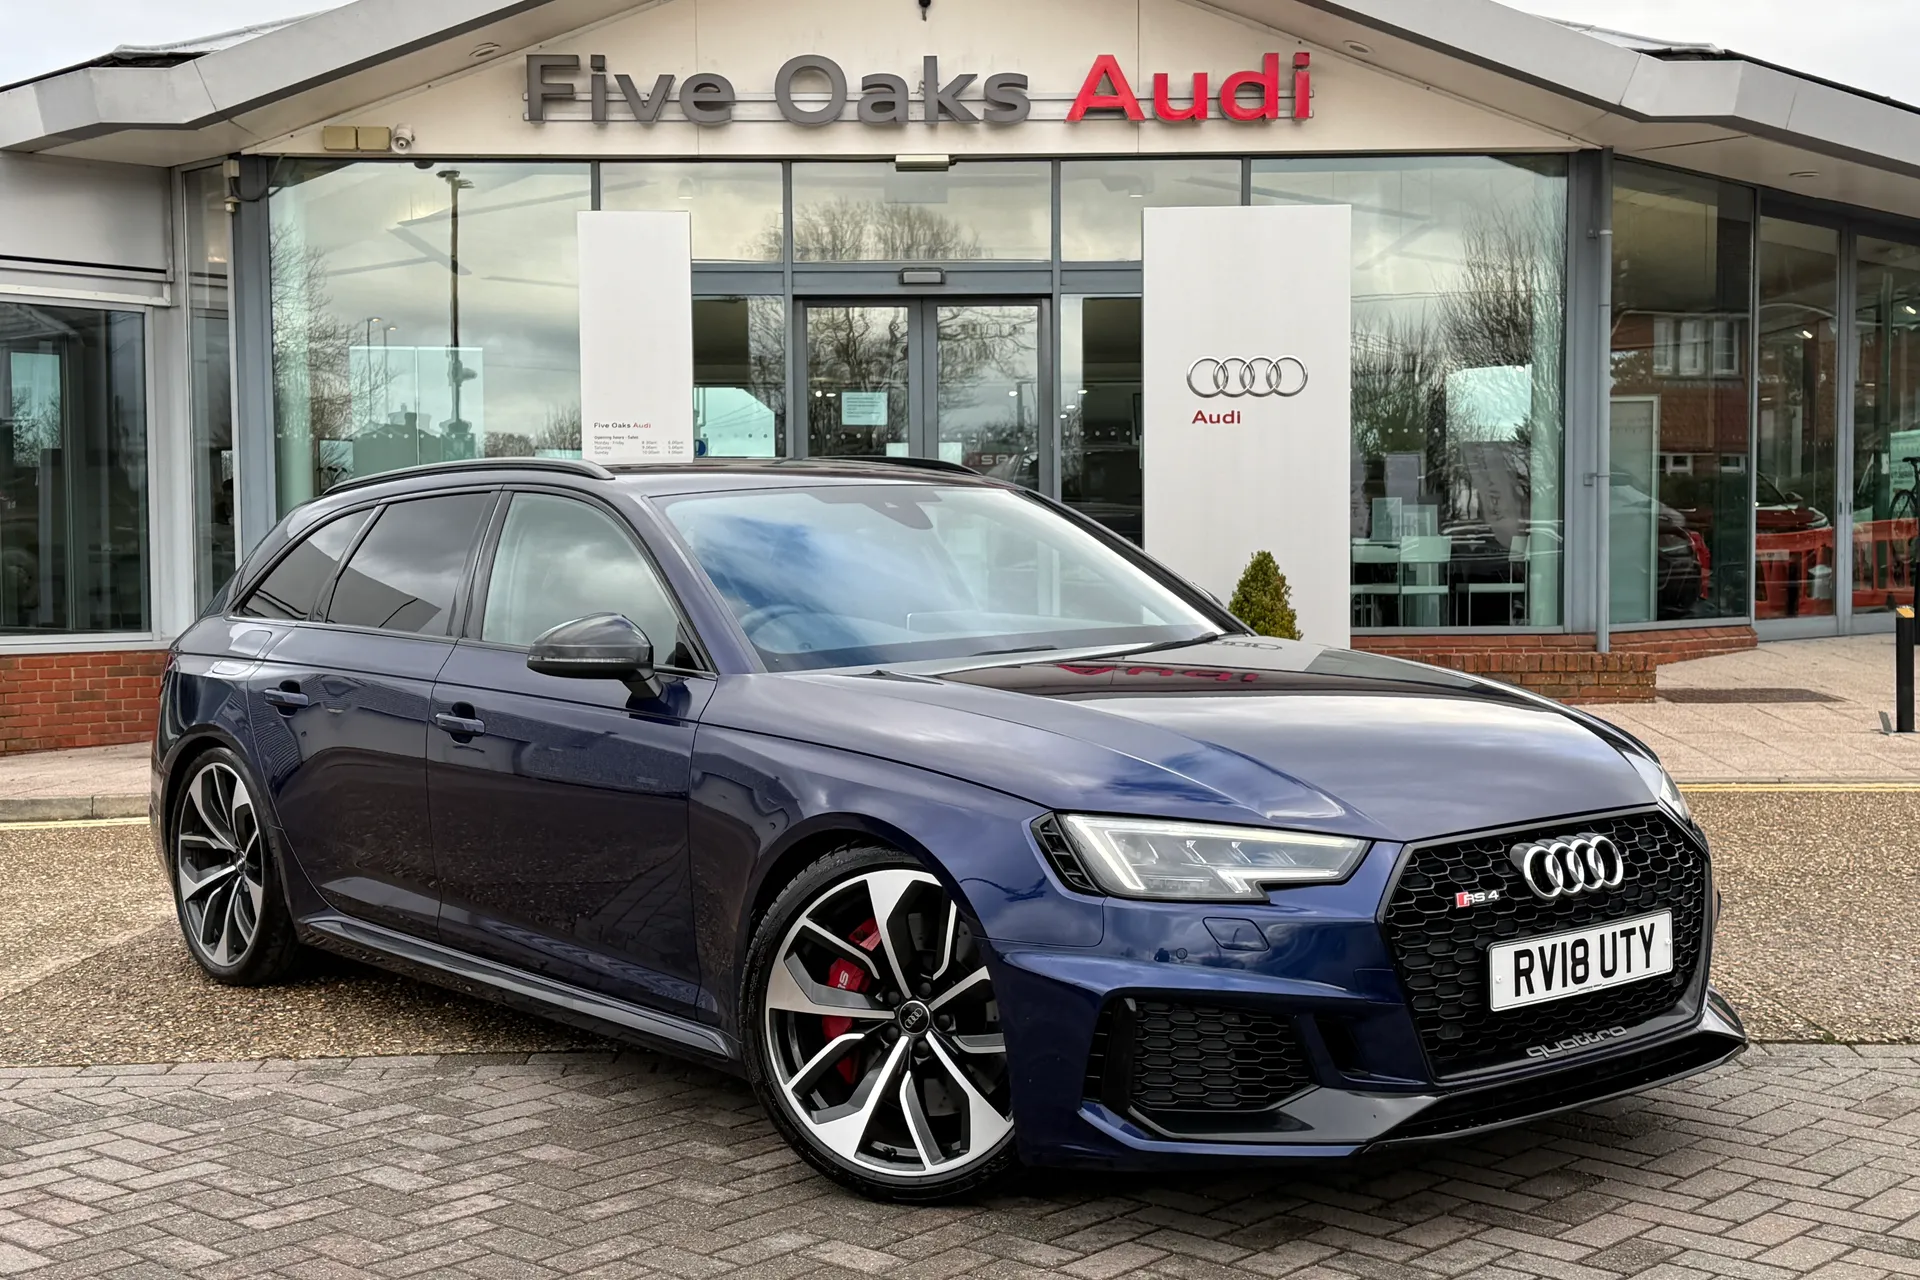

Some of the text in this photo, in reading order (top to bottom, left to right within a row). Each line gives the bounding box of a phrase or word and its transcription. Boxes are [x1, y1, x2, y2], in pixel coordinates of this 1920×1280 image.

[526, 52, 1311, 126] Five Oaks Audi
[1191, 409, 1242, 424] Audi
[1460, 889, 1500, 906] RS 4
[1513, 922, 1655, 997] RV18 UTY
[1526, 1025, 1627, 1058] quattro
